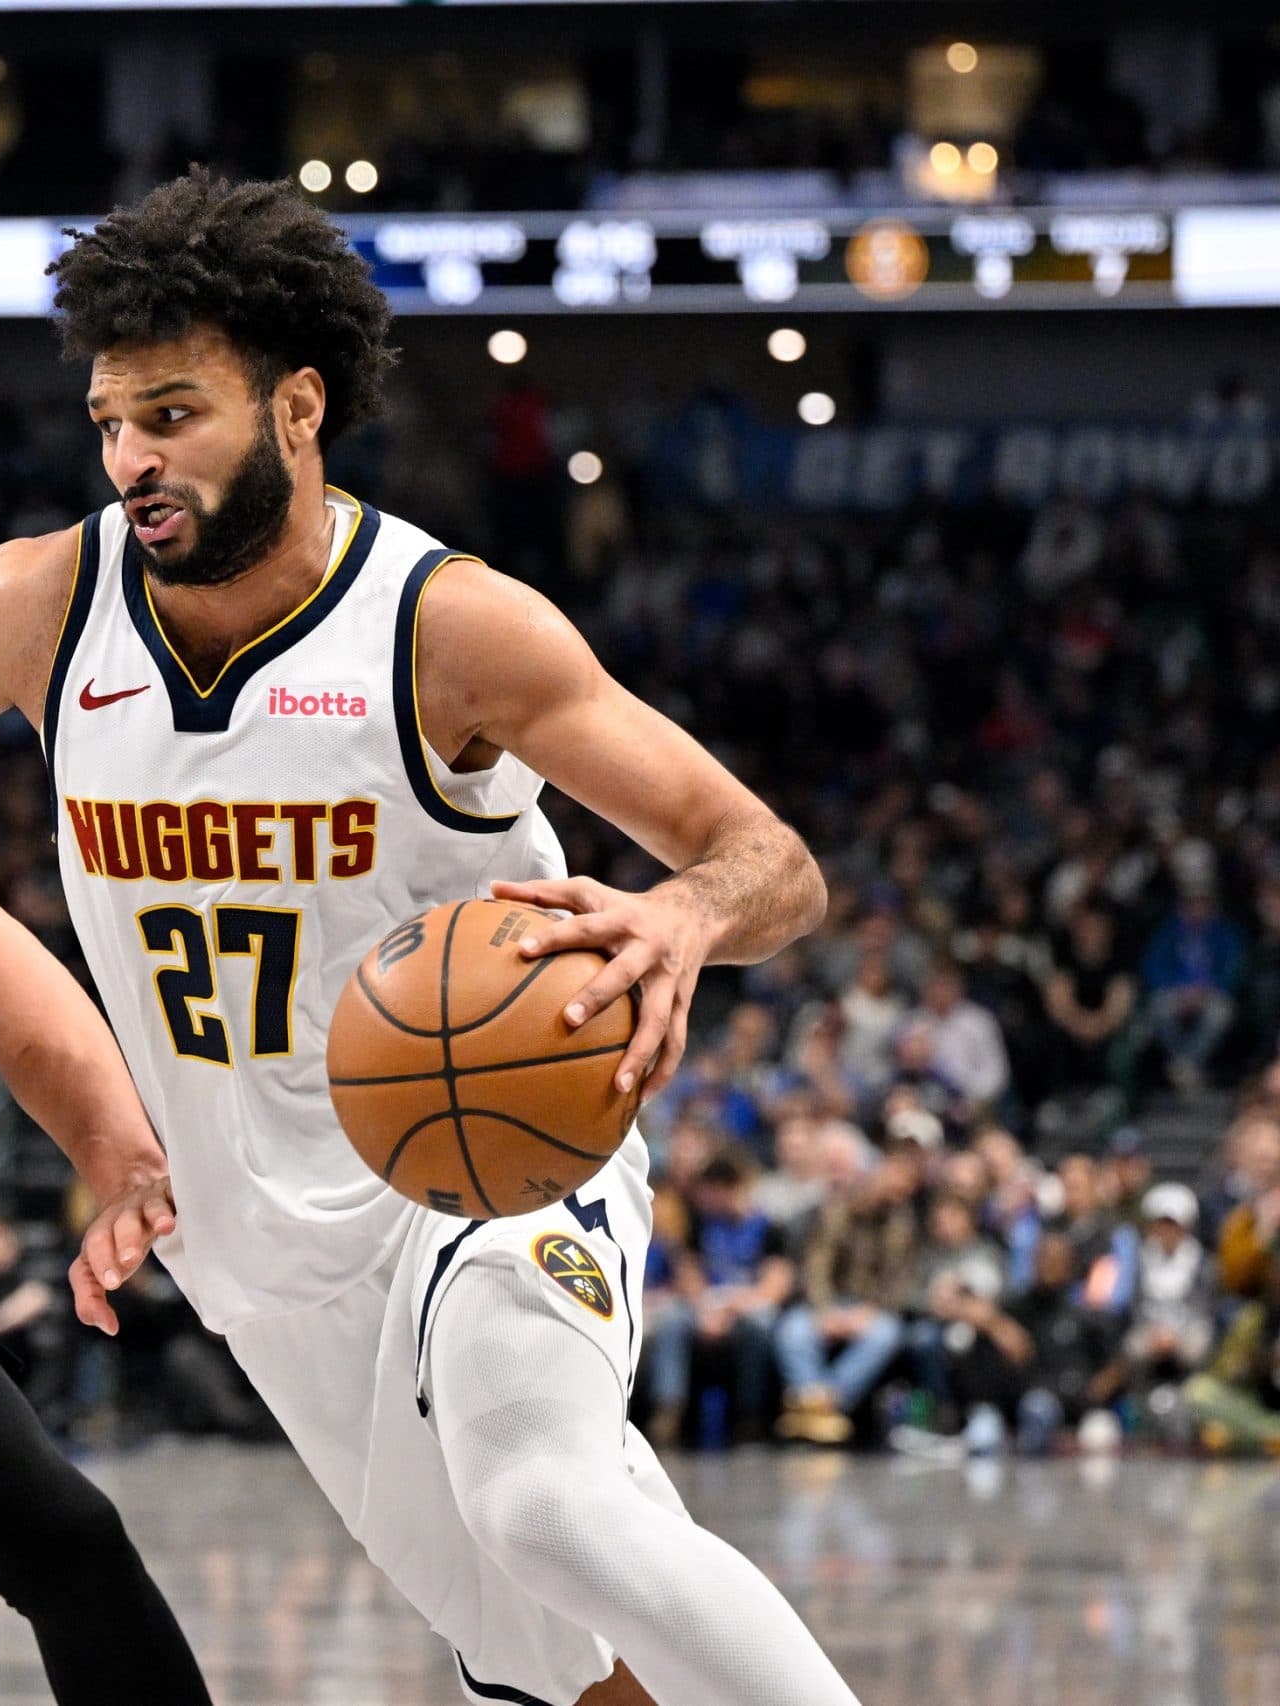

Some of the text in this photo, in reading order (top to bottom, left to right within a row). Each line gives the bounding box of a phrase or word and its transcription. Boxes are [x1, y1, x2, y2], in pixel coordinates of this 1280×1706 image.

[268, 687, 367, 717] ibotta
[64, 796, 379, 884] NUGGETS
[134, 903, 303, 1069] 27
